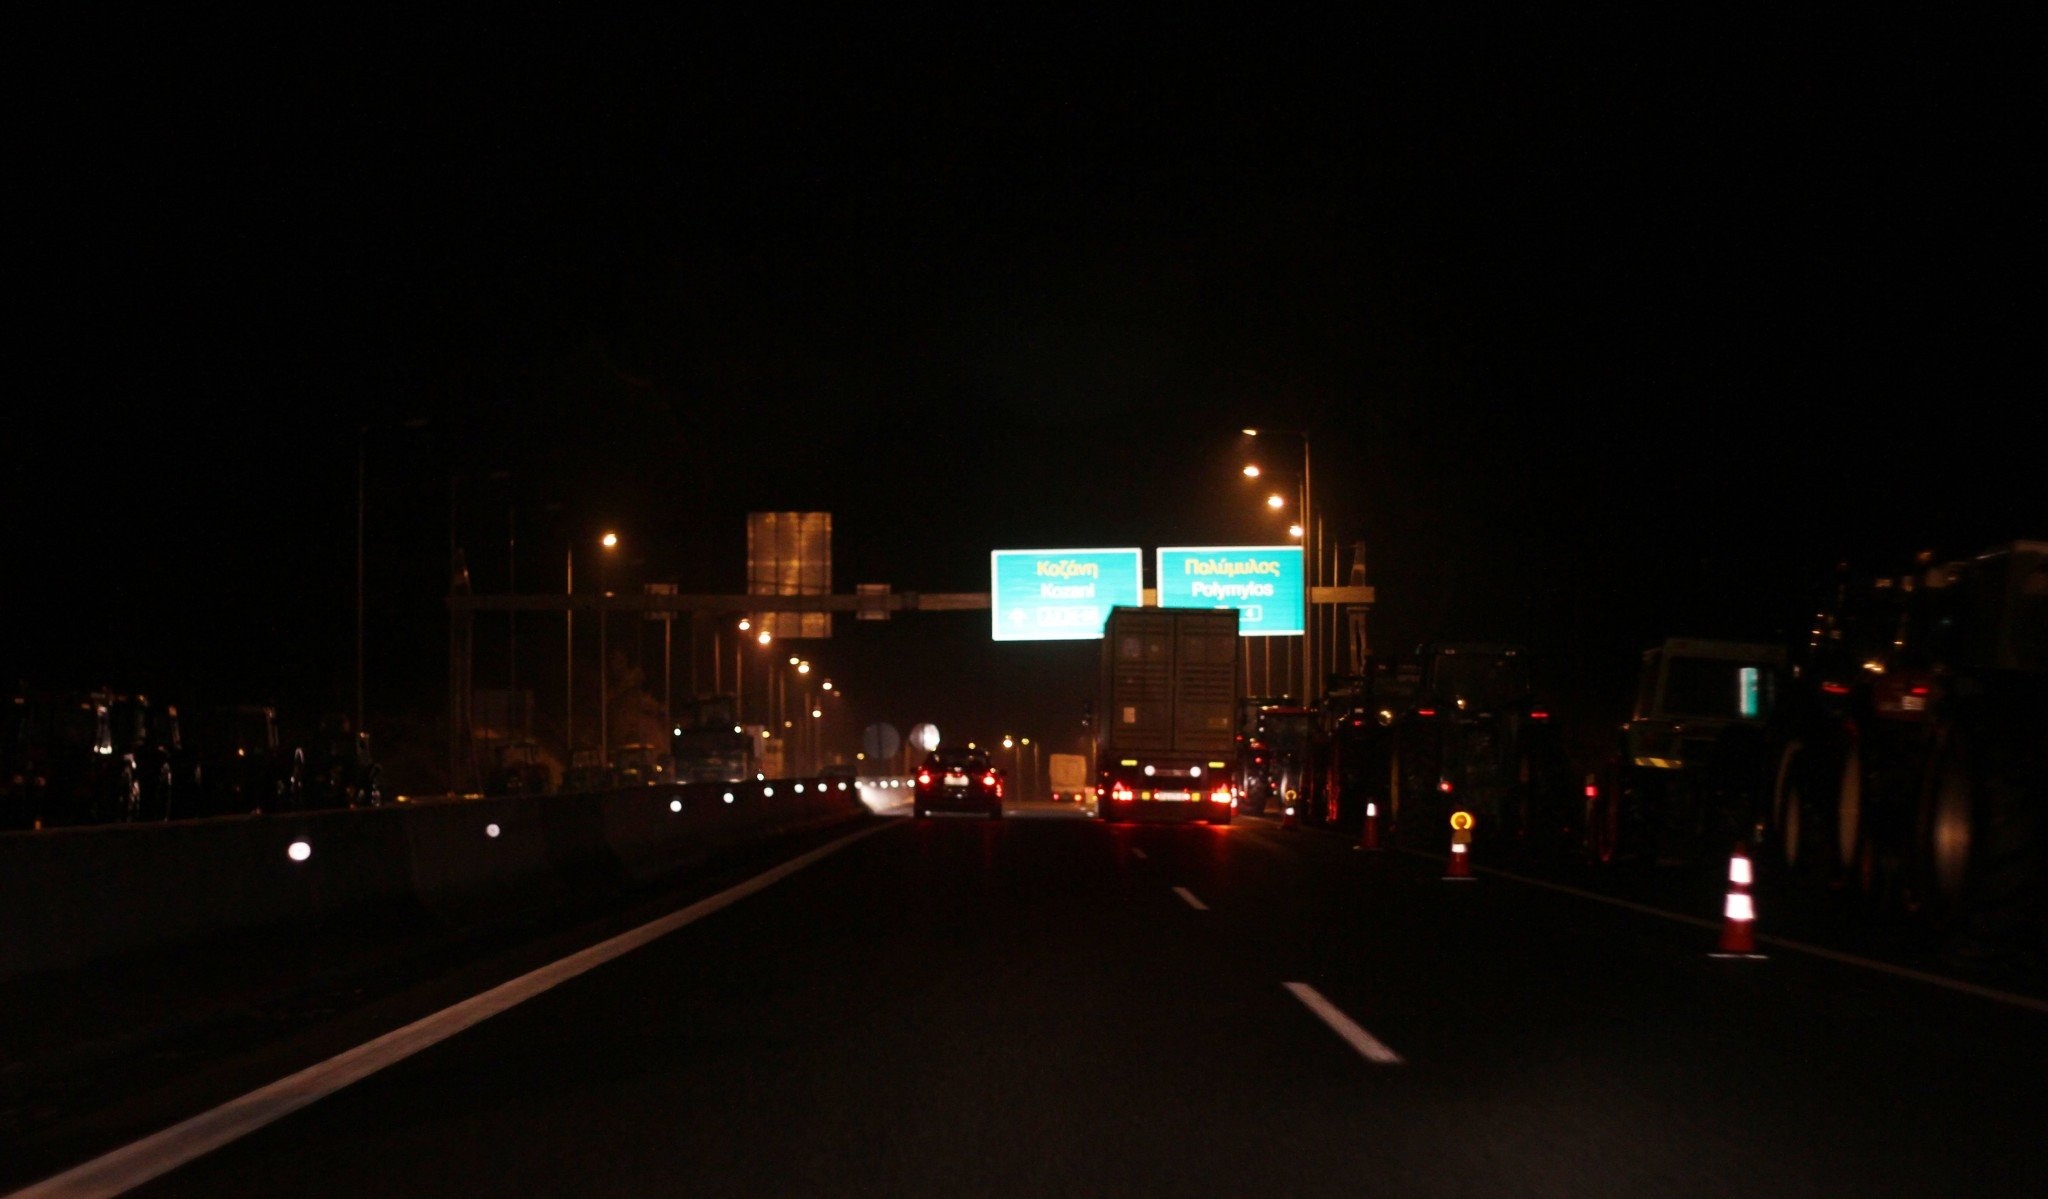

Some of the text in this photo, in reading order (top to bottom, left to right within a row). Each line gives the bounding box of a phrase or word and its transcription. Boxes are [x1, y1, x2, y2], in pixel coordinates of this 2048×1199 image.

[1037, 560, 1098, 579] Κοζάνη
[1186, 559, 1280, 577] Πολύμυλος
[1192, 581, 1274, 600] Polymylos
